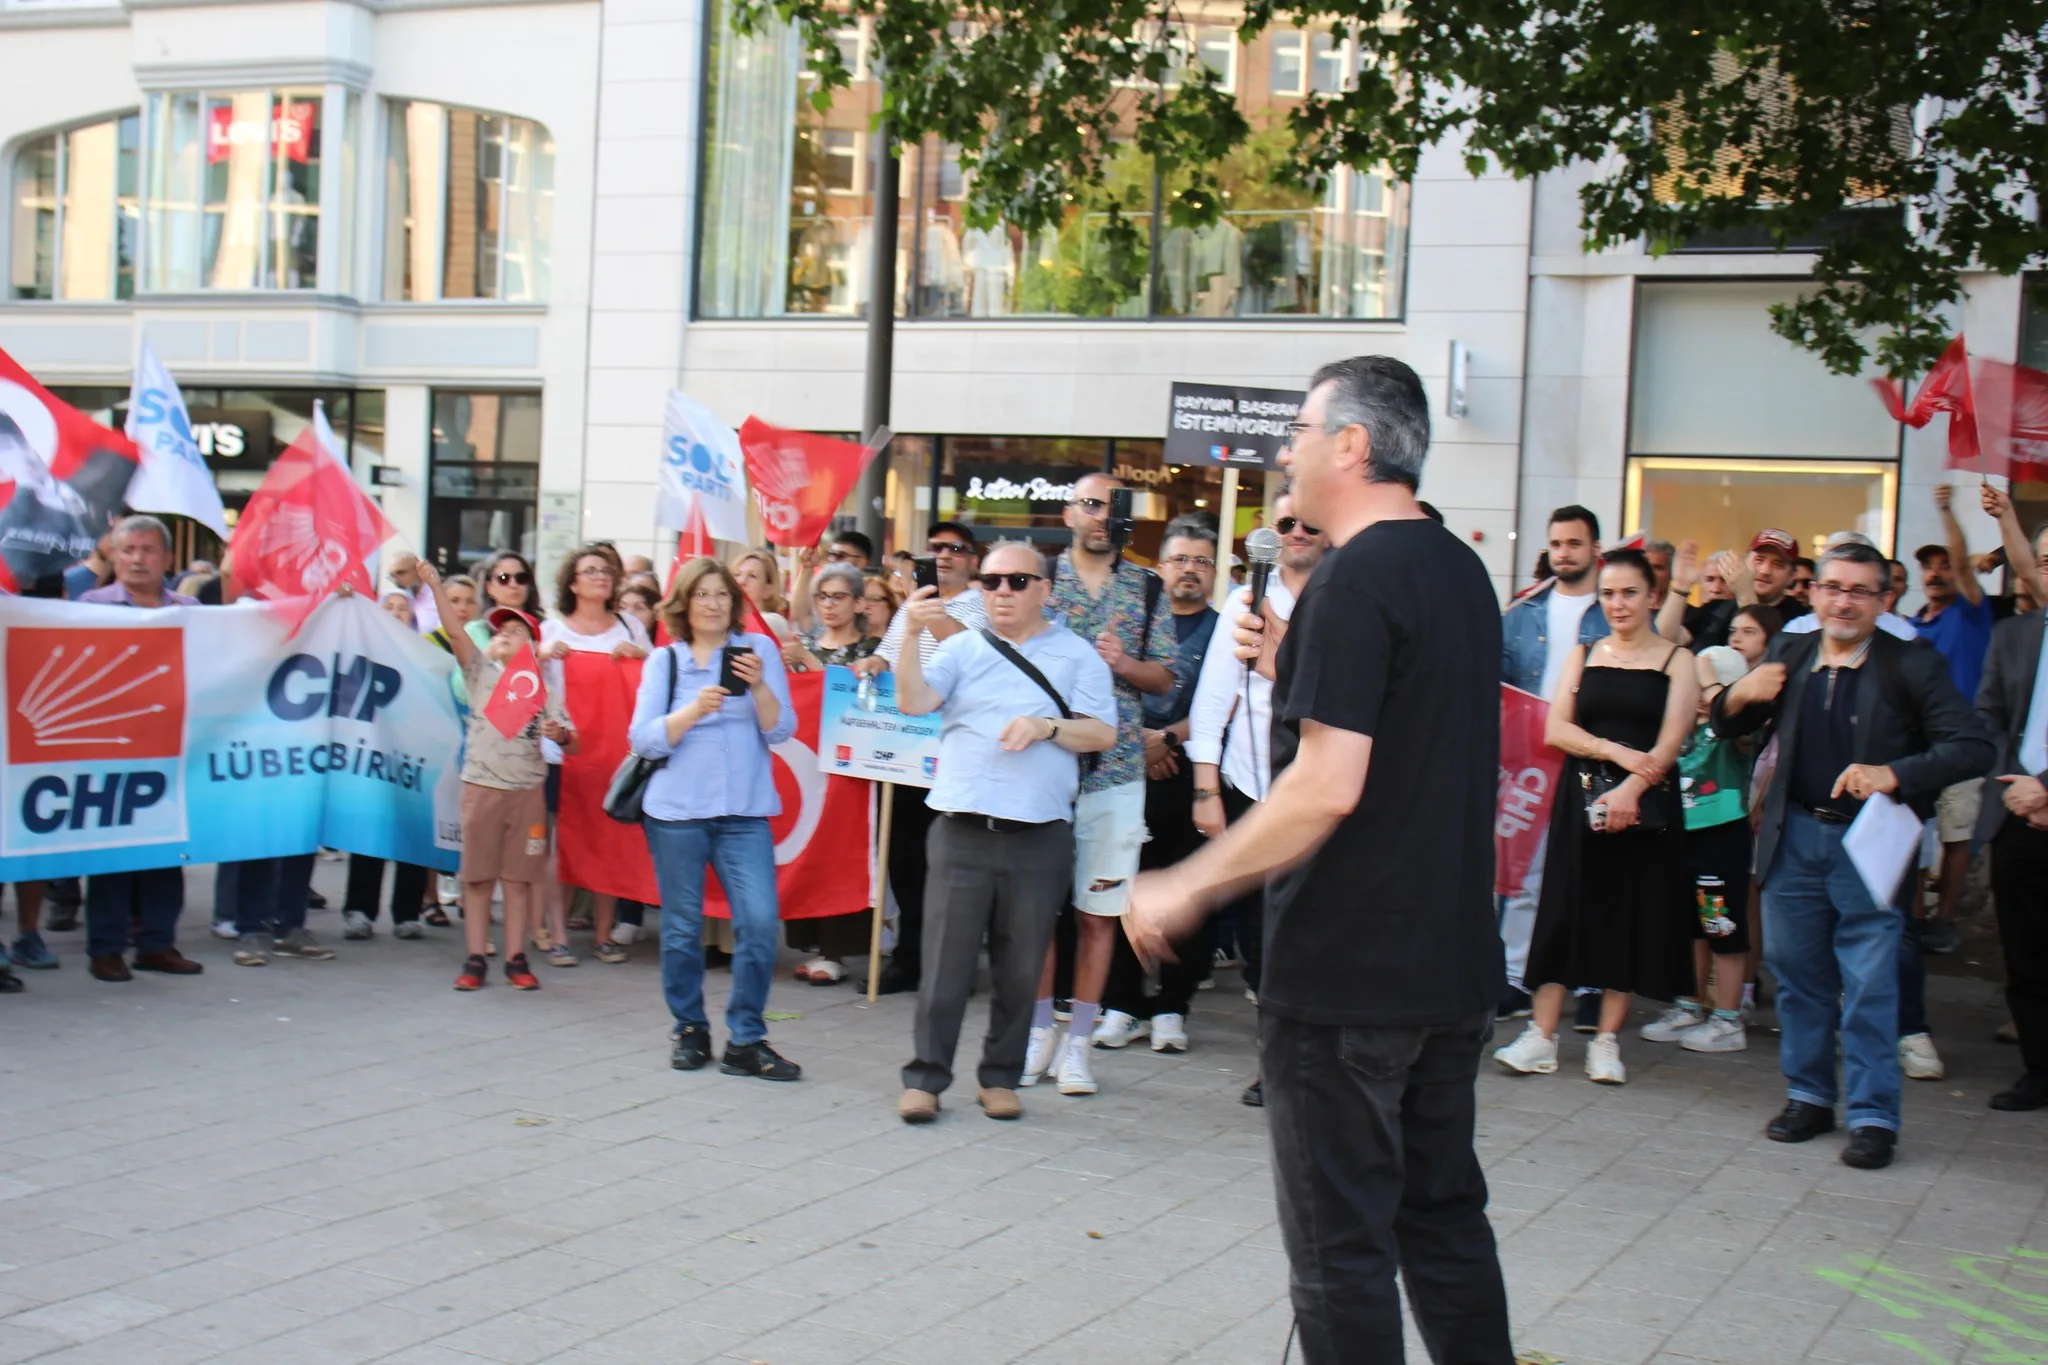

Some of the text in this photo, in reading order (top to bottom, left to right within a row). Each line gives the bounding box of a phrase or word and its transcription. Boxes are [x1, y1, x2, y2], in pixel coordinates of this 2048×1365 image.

[668, 435, 731, 483] SOL
[267, 653, 402, 723] CHP
[21, 771, 167, 834] CHP
